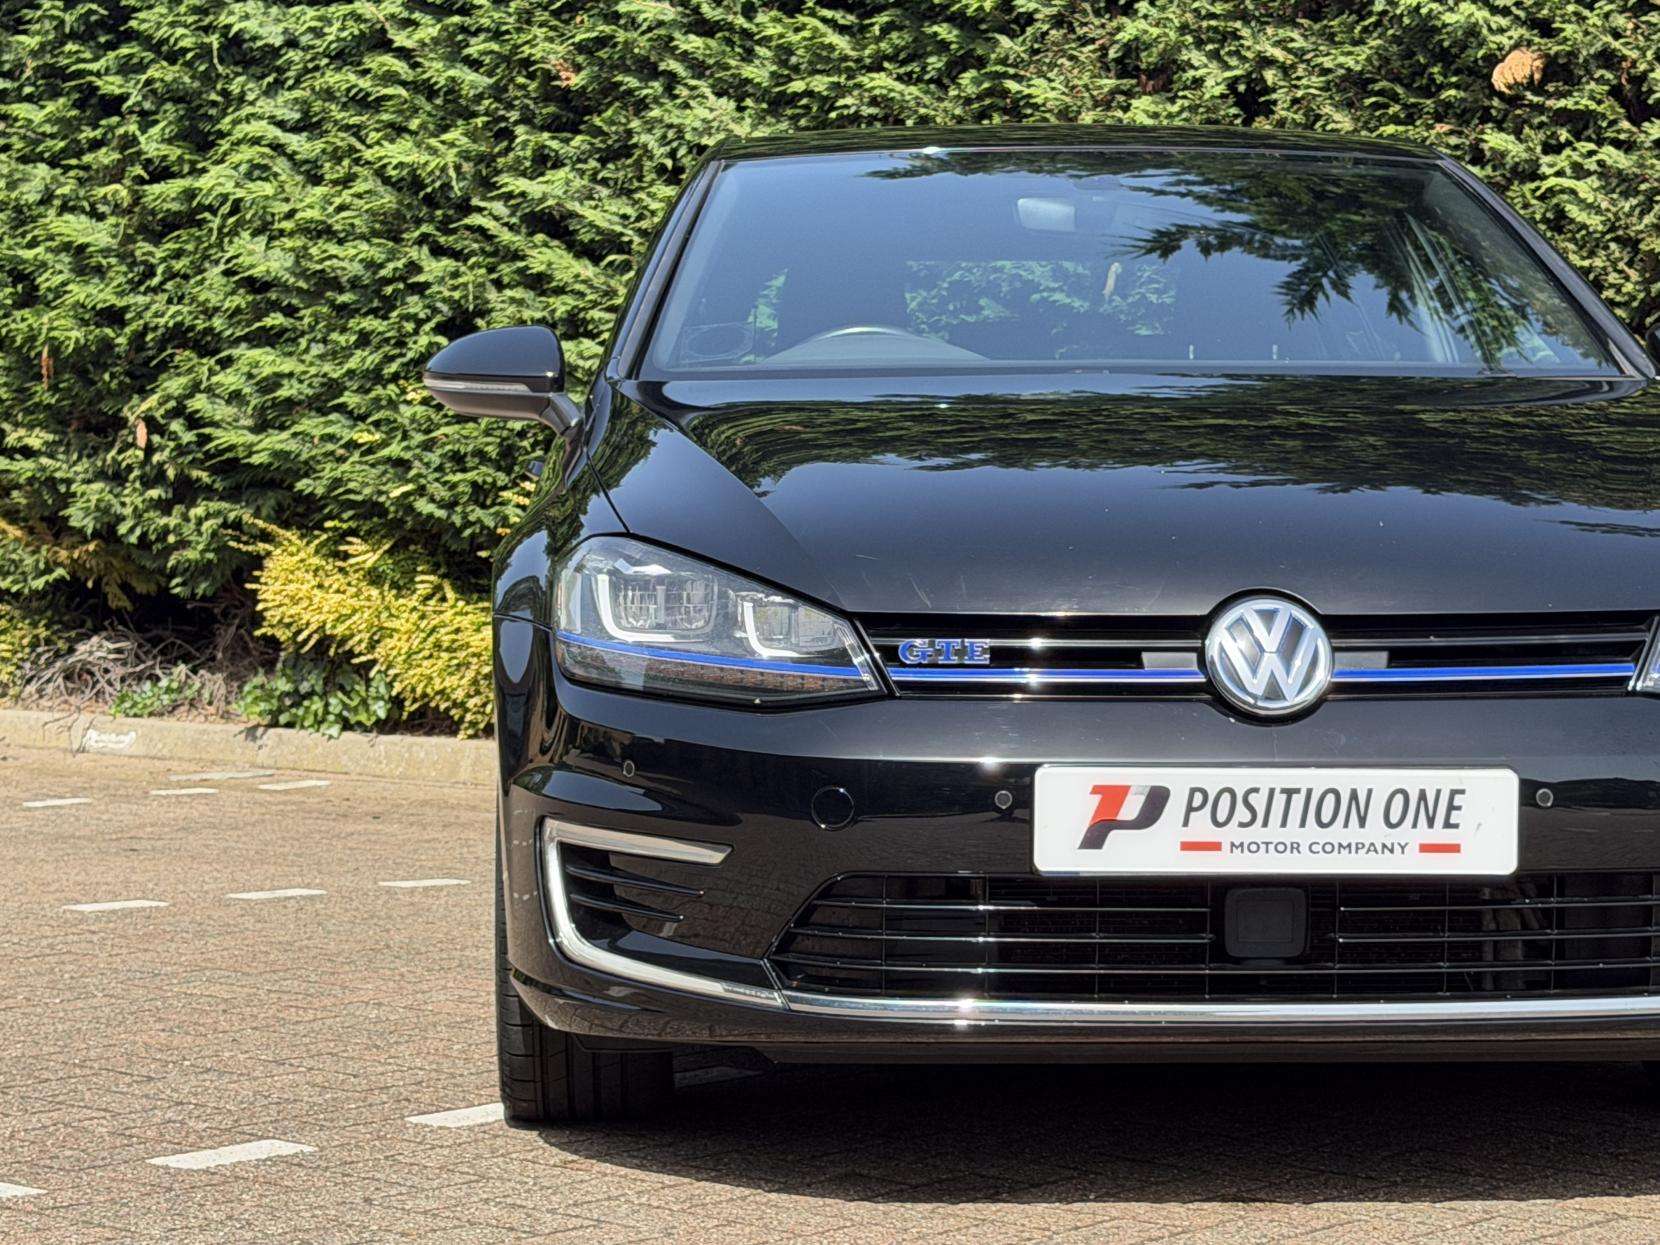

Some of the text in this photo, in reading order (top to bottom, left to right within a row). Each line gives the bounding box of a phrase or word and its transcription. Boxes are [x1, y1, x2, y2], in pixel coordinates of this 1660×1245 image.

[899, 638, 991, 664] GTE
[1215, 606, 1321, 703] VW
[1181, 787, 1466, 830] POSITION ONE
[1229, 841, 1410, 856] MOTOR COMPANY
